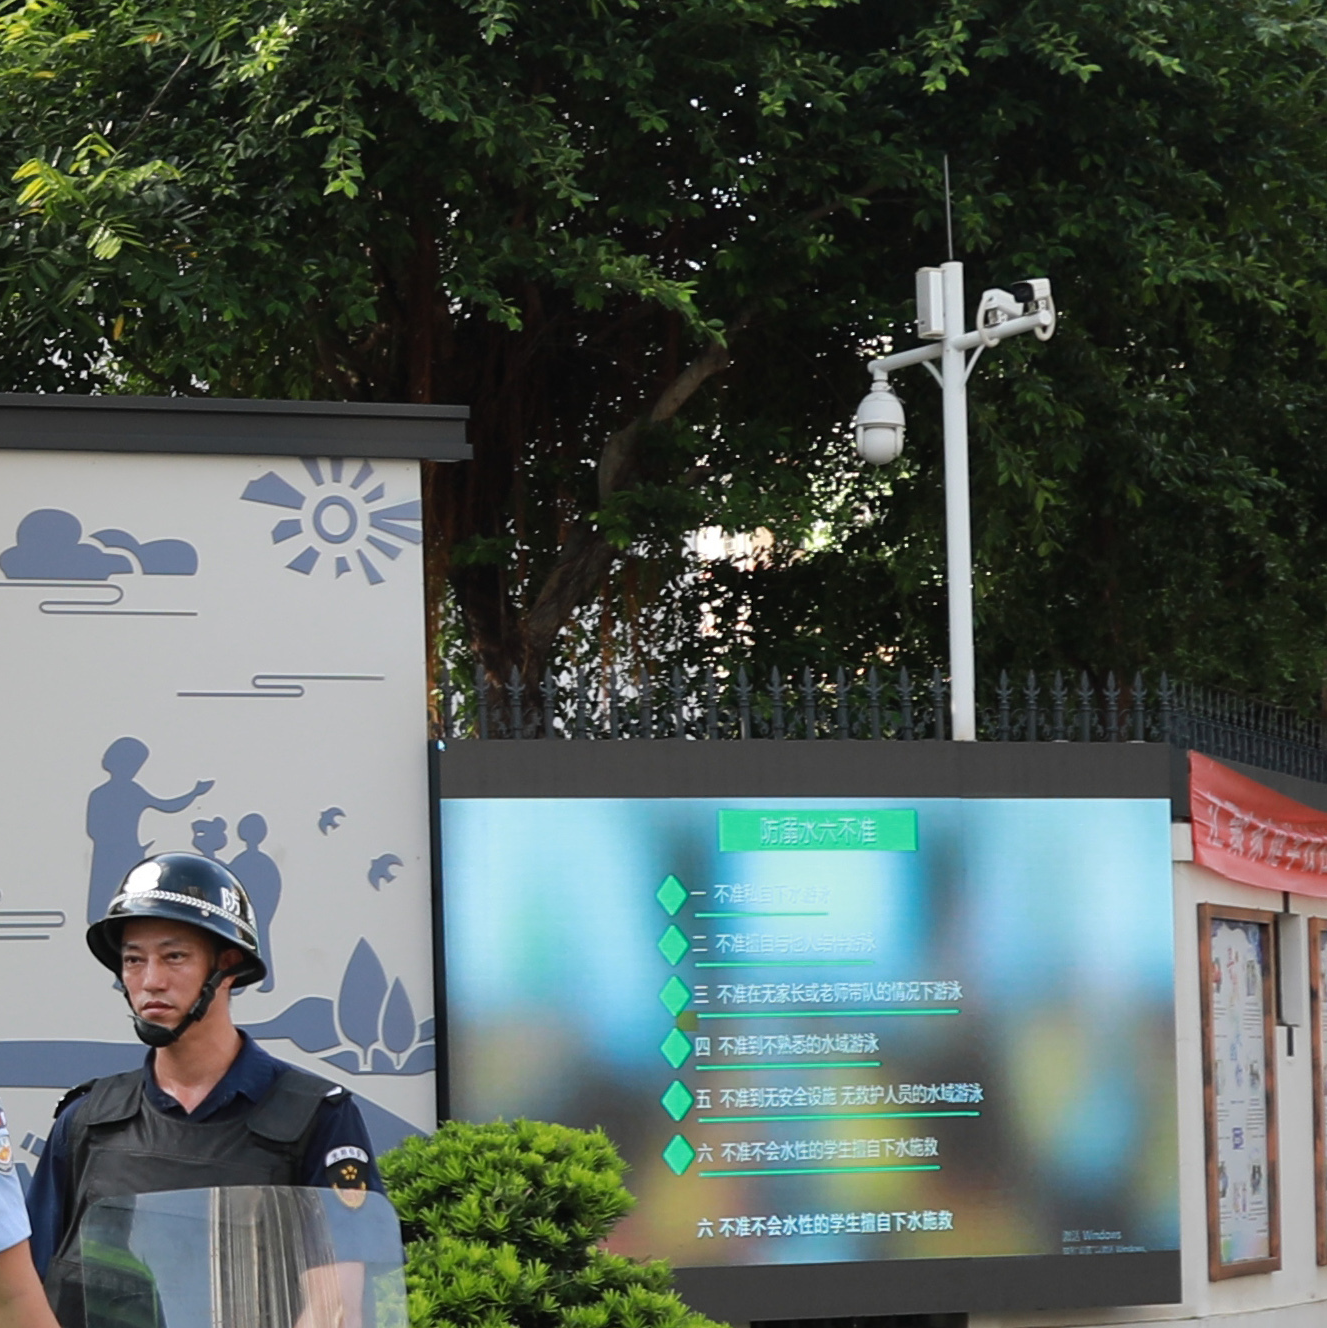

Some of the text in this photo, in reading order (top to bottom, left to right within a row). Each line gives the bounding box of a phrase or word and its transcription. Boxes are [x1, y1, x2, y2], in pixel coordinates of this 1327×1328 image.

[760, 817, 878, 845] 防溺水六不准
[694, 980, 964, 1006] 三 不准在无家长或老师带队的情况下游泳
[695, 1033, 880, 1056] 四 不准到不熟悉的水域游泳
[696, 1082, 985, 1109] 五 不准到无安全设施 无救护人员的水域游泳
[696, 1137, 939, 1163] 六 不准不会水性的学生擅自下水施救
[696, 1210, 953, 1238] 六 不准不会水性的学生擅自下水施救
